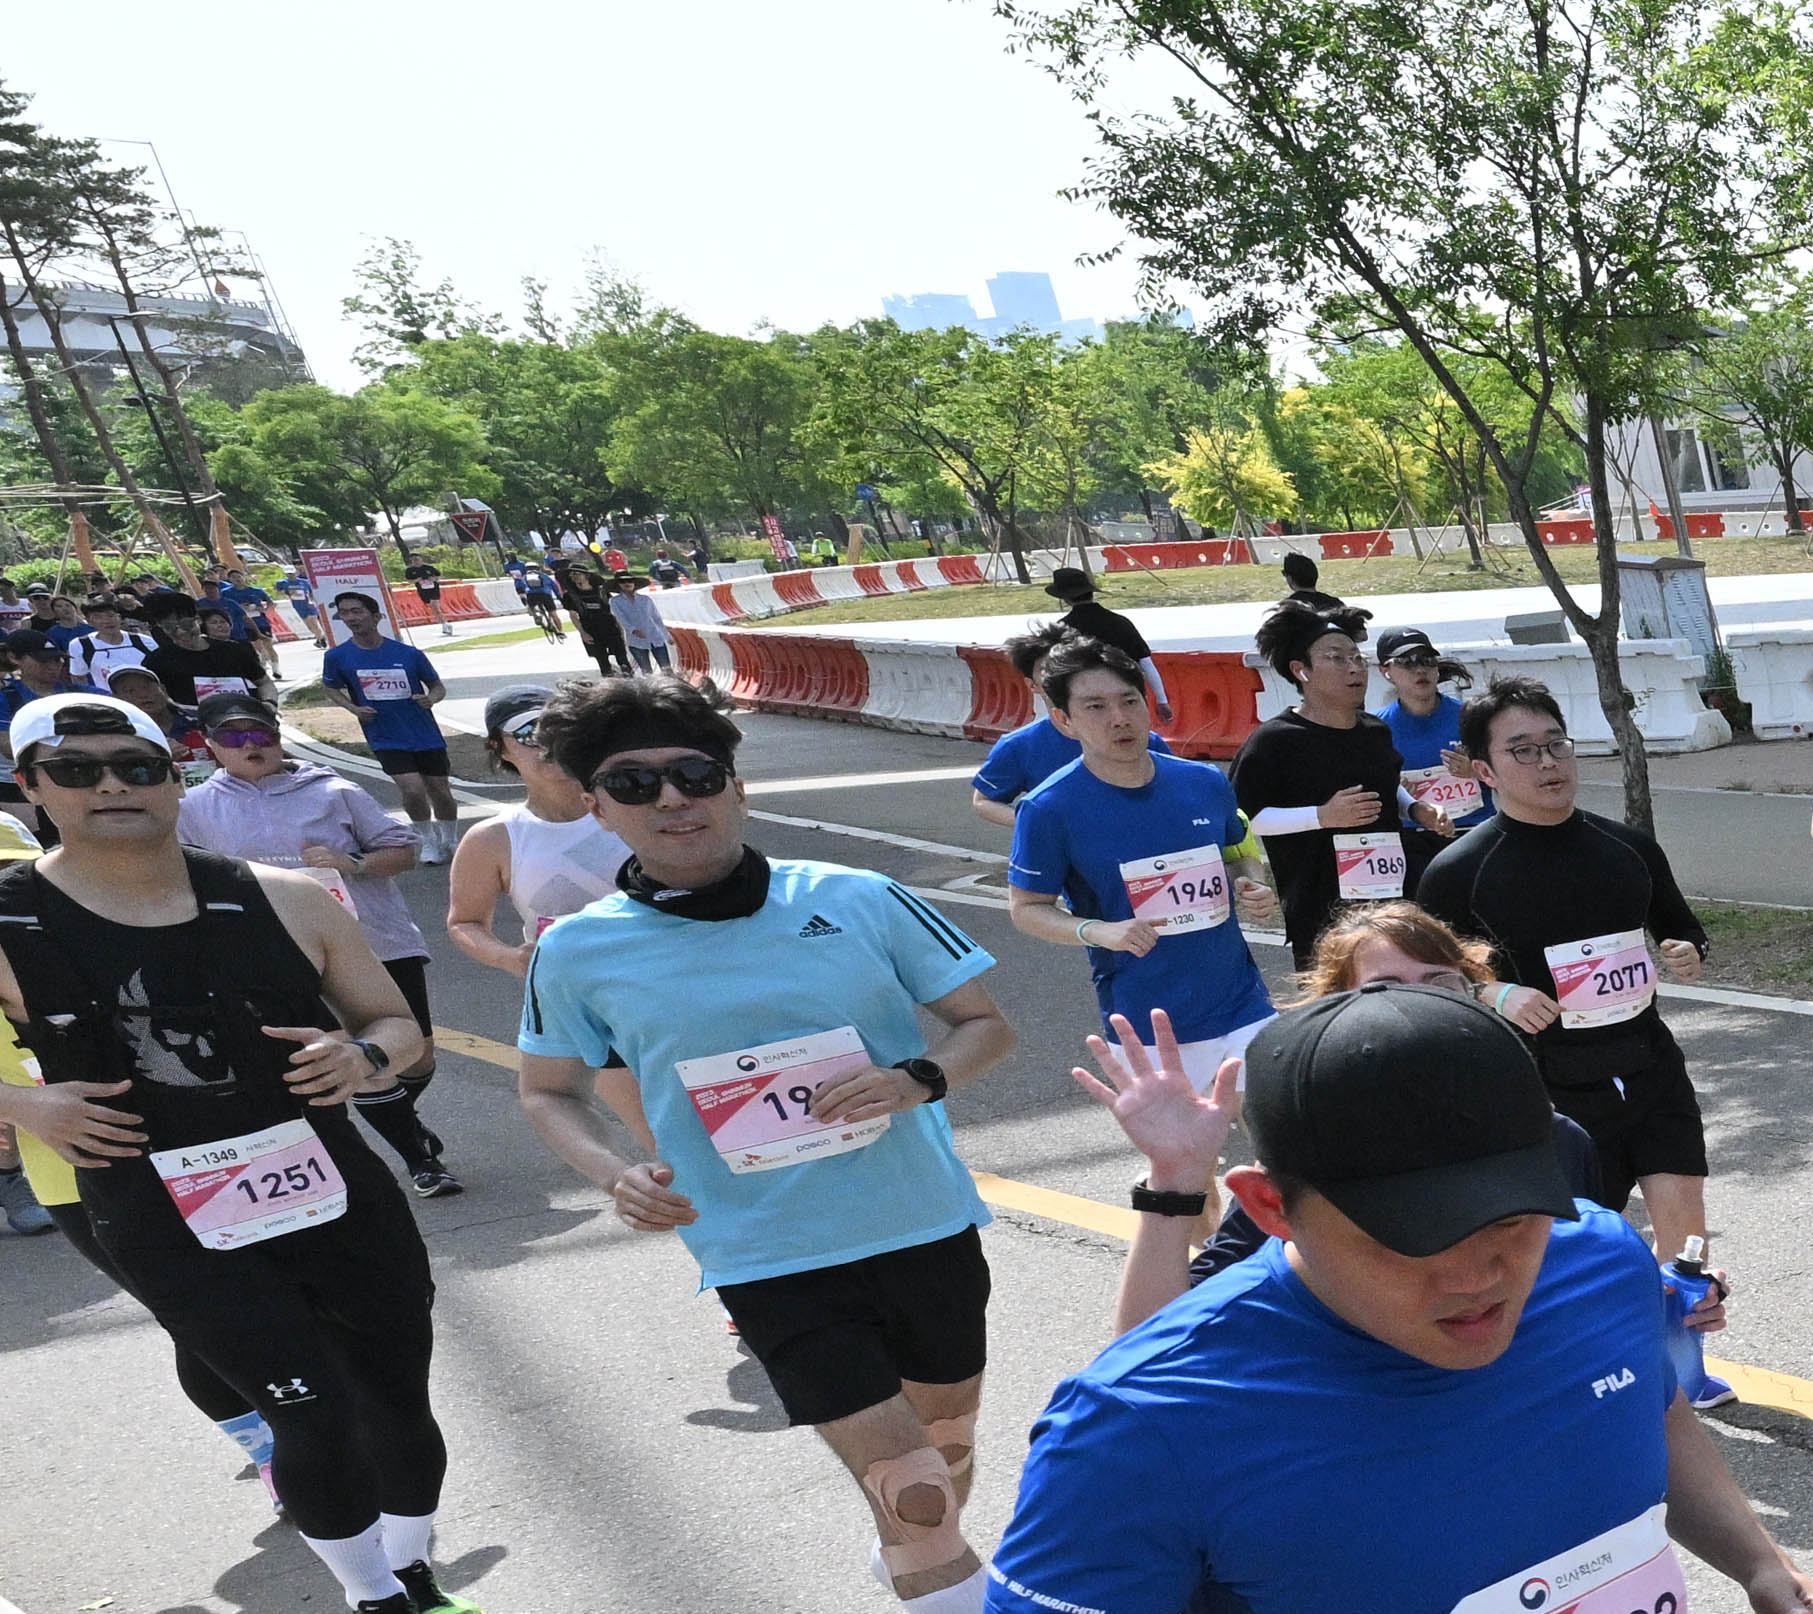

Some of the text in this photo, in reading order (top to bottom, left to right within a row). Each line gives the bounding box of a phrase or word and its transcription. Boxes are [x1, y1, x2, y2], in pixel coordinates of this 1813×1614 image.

[376, 680, 408, 691] 2710
[1432, 781, 1478, 802] 3212
[1366, 857, 1405, 876] 1869
[1167, 876, 1223, 906] 1948
[799, 926, 843, 939] adidas
[1593, 961, 1649, 997] 2077
[763, 1080, 825, 1122] 19
[181, 1148, 239, 1169] A-1349
[236, 1156, 328, 1205] 1251
[1591, 1367, 1636, 1399] FILA
[1554, 1551, 1613, 1590] 인사혁신처
[1007, 1579, 1033, 1598] HALF
